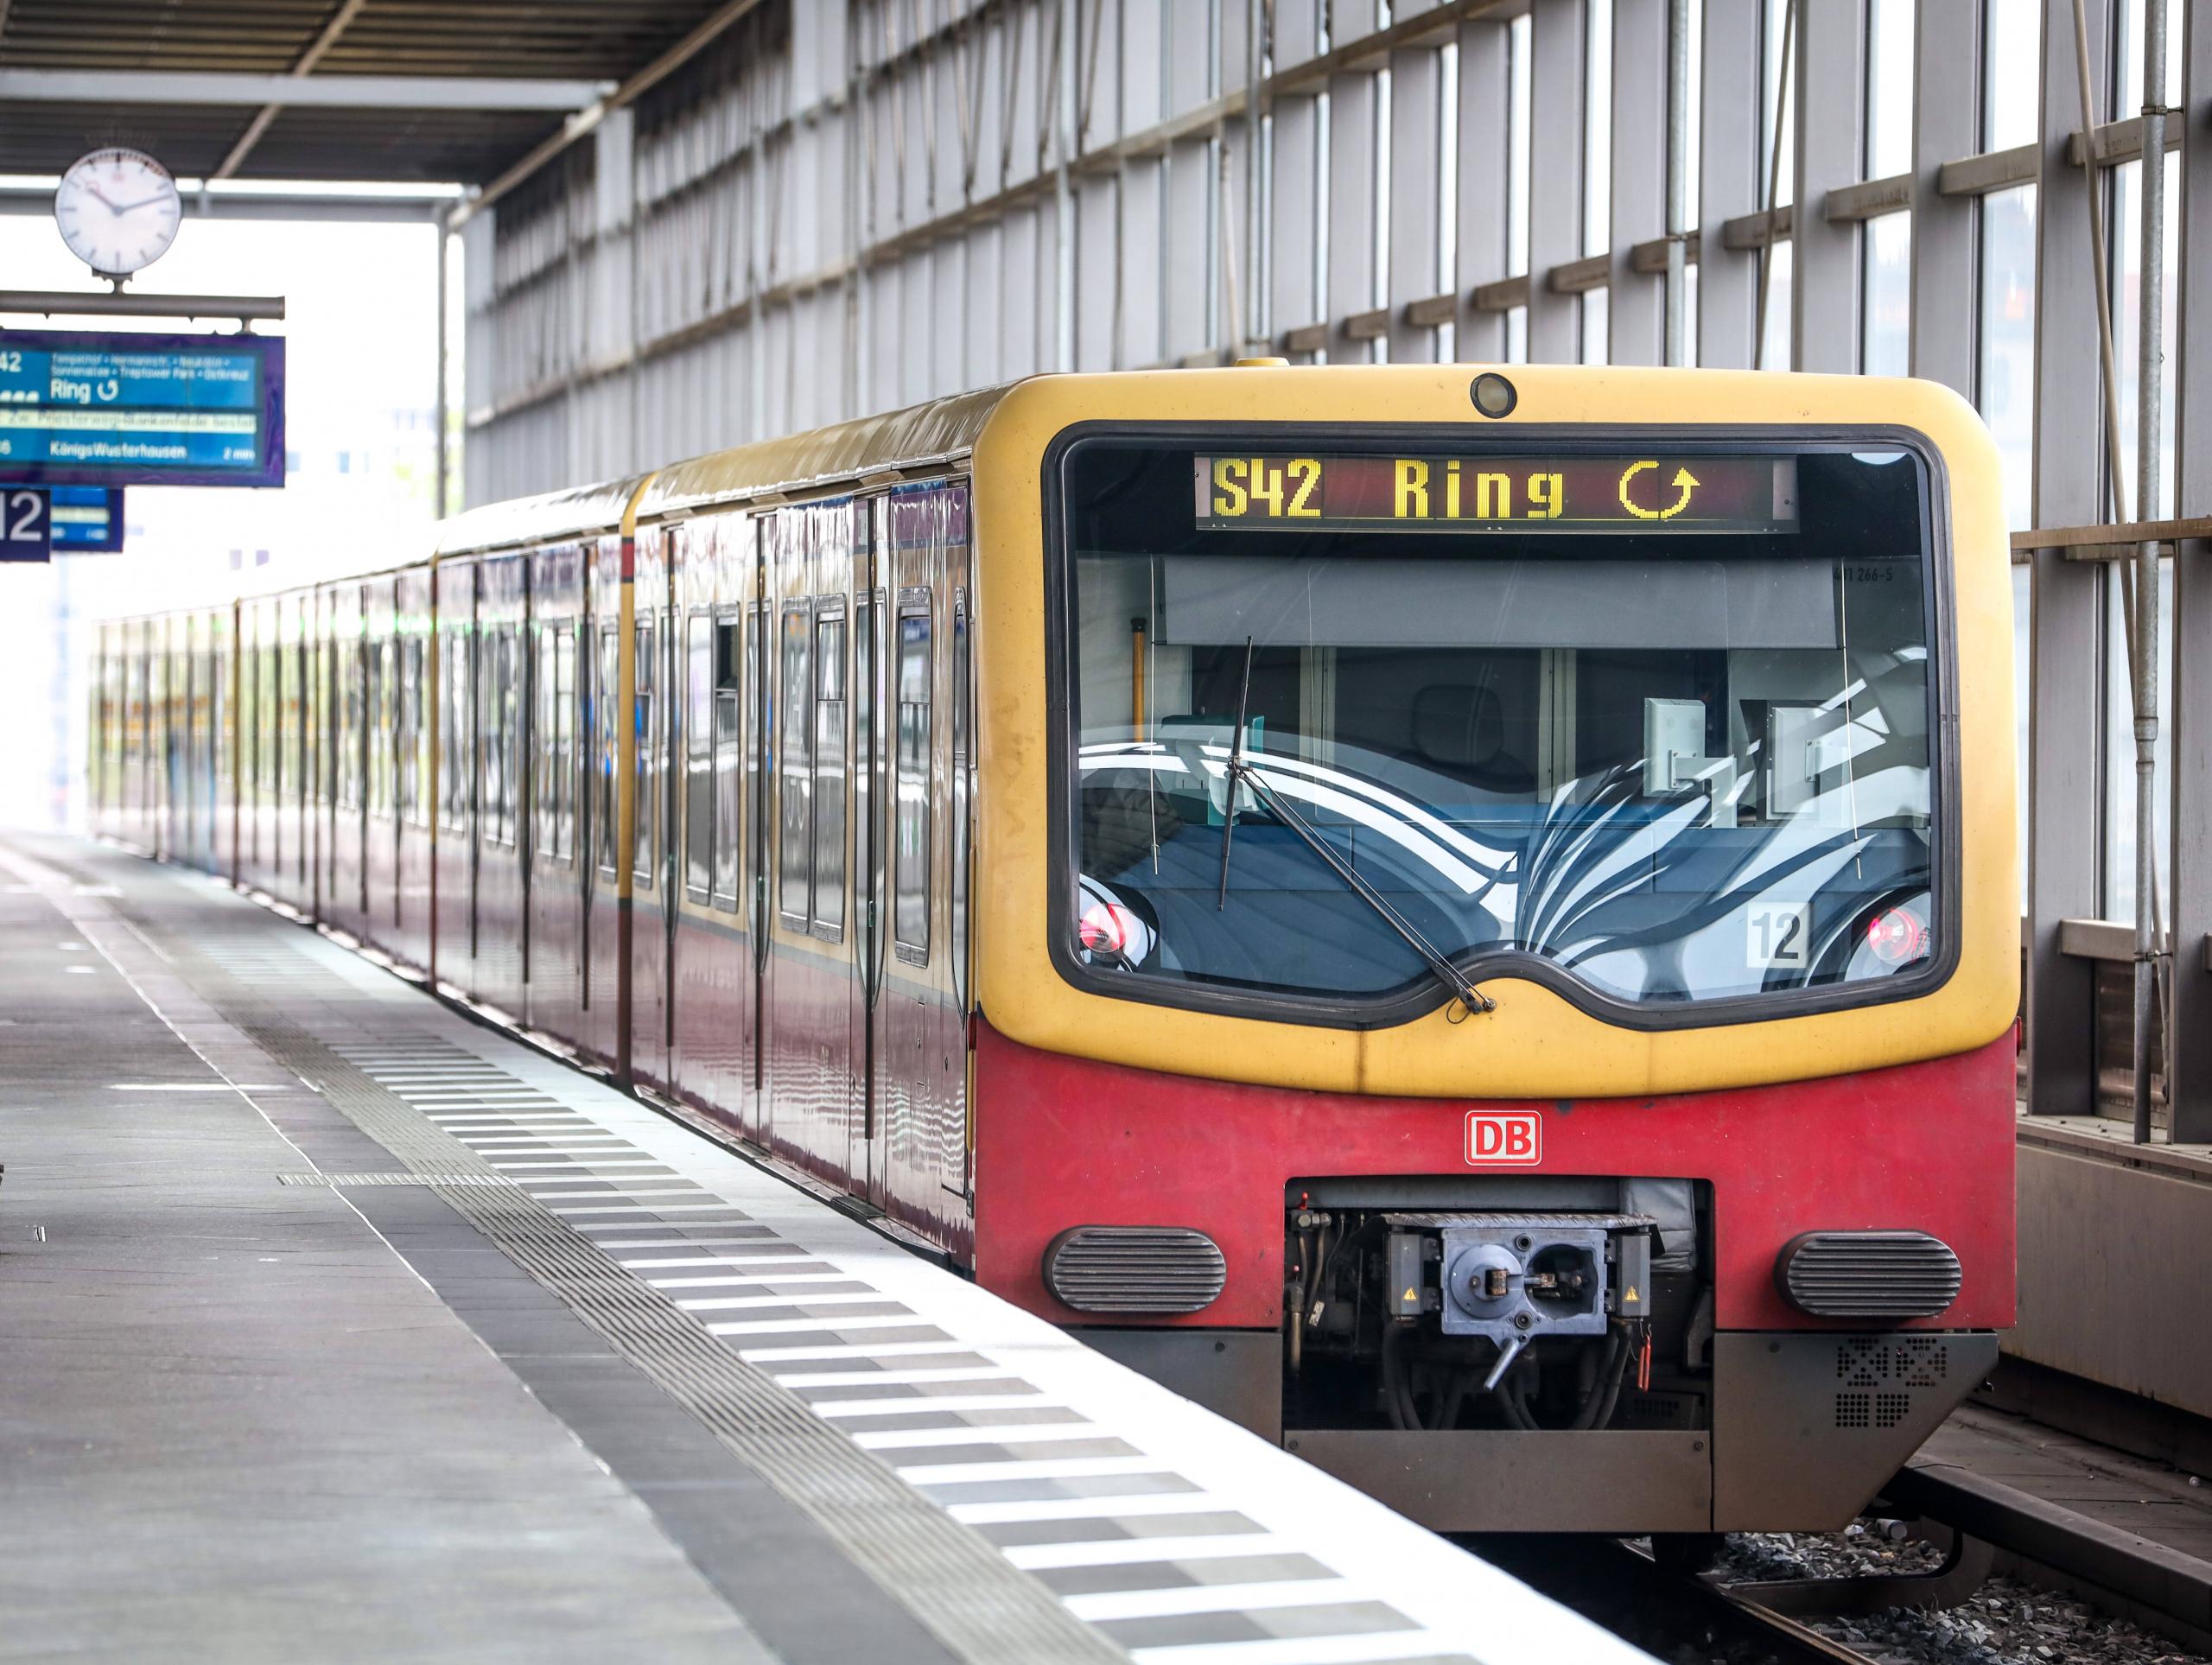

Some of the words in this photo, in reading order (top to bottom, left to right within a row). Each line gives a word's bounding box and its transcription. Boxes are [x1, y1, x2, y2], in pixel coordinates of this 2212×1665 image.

[50, 378, 91, 404] Ring
[1213, 458, 1321, 517] S42
[1395, 459, 1563, 518] Ring
[0, 491, 42, 542] 12
[1858, 567, 1892, 581] 266-5
[1751, 912, 1801, 960] 12
[1476, 1120, 1532, 1155] DB
